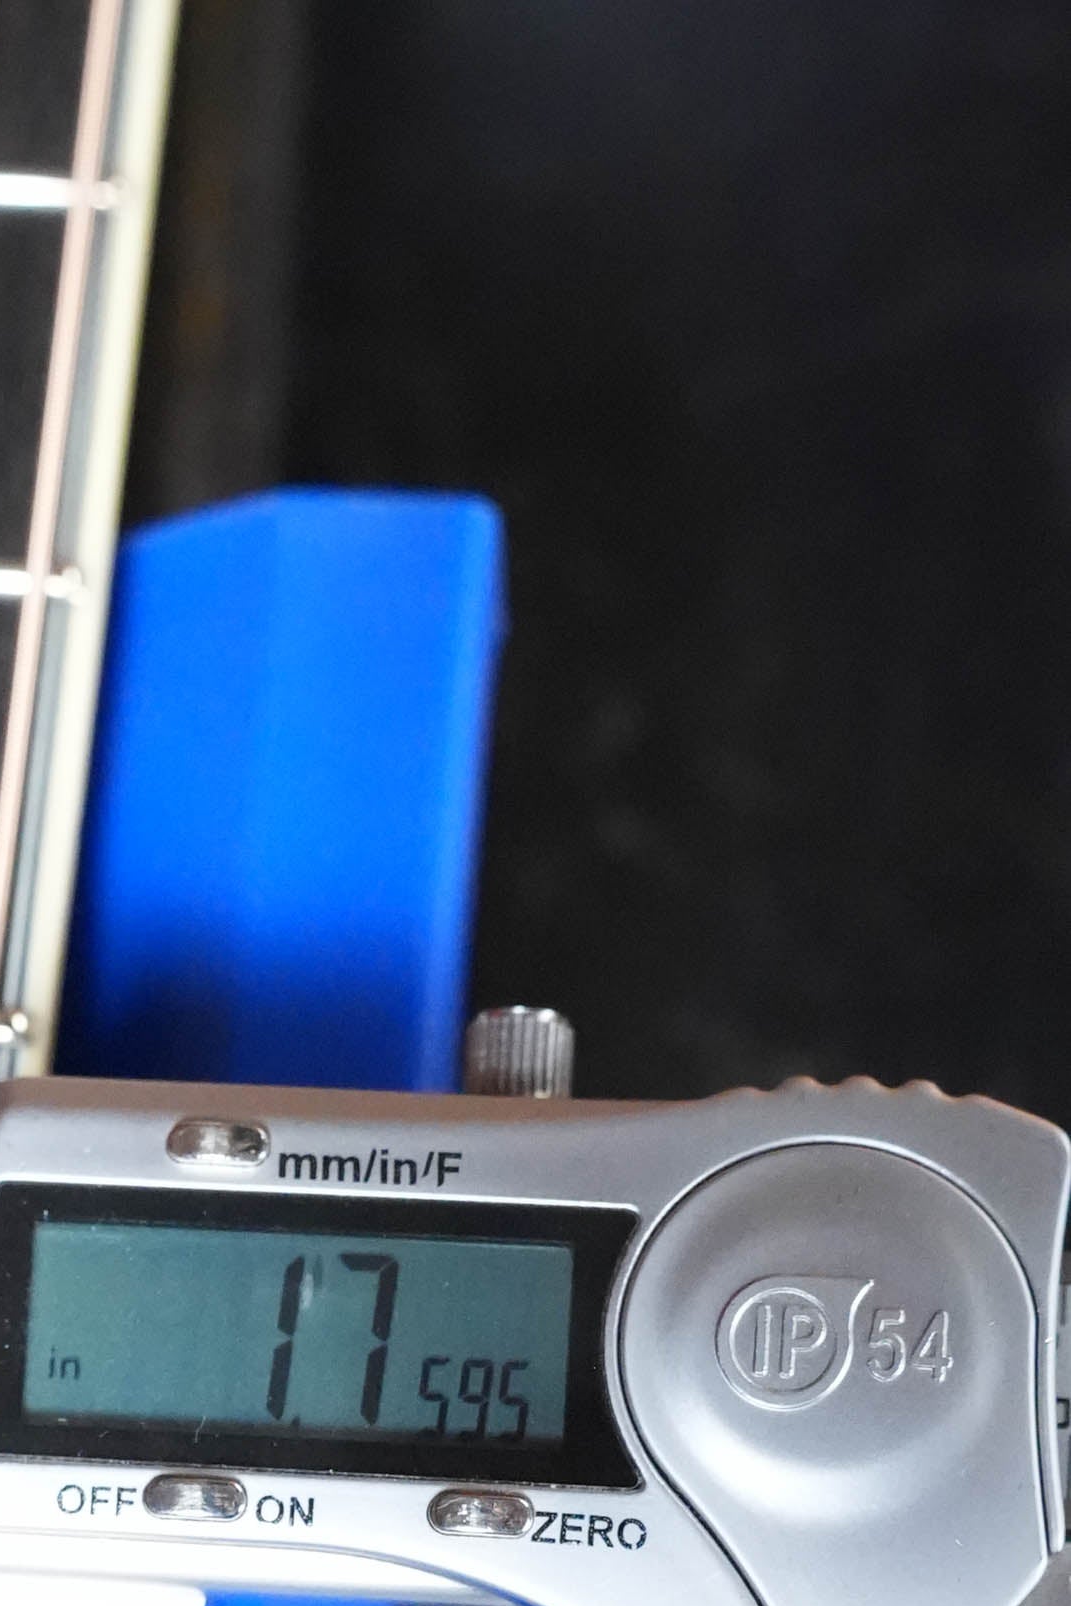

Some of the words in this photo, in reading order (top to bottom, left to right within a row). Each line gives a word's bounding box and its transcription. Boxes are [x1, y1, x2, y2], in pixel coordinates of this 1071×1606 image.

[278, 1149, 463, 1188] mm/in/F
[750, 1303, 828, 1381] IP
[866, 1307, 954, 1384] 54
[48, 1350, 82, 1381] in
[56, 1484, 139, 1518] OFF
[255, 1495, 316, 1528] ON
[531, 1511, 649, 1551] ZERO
